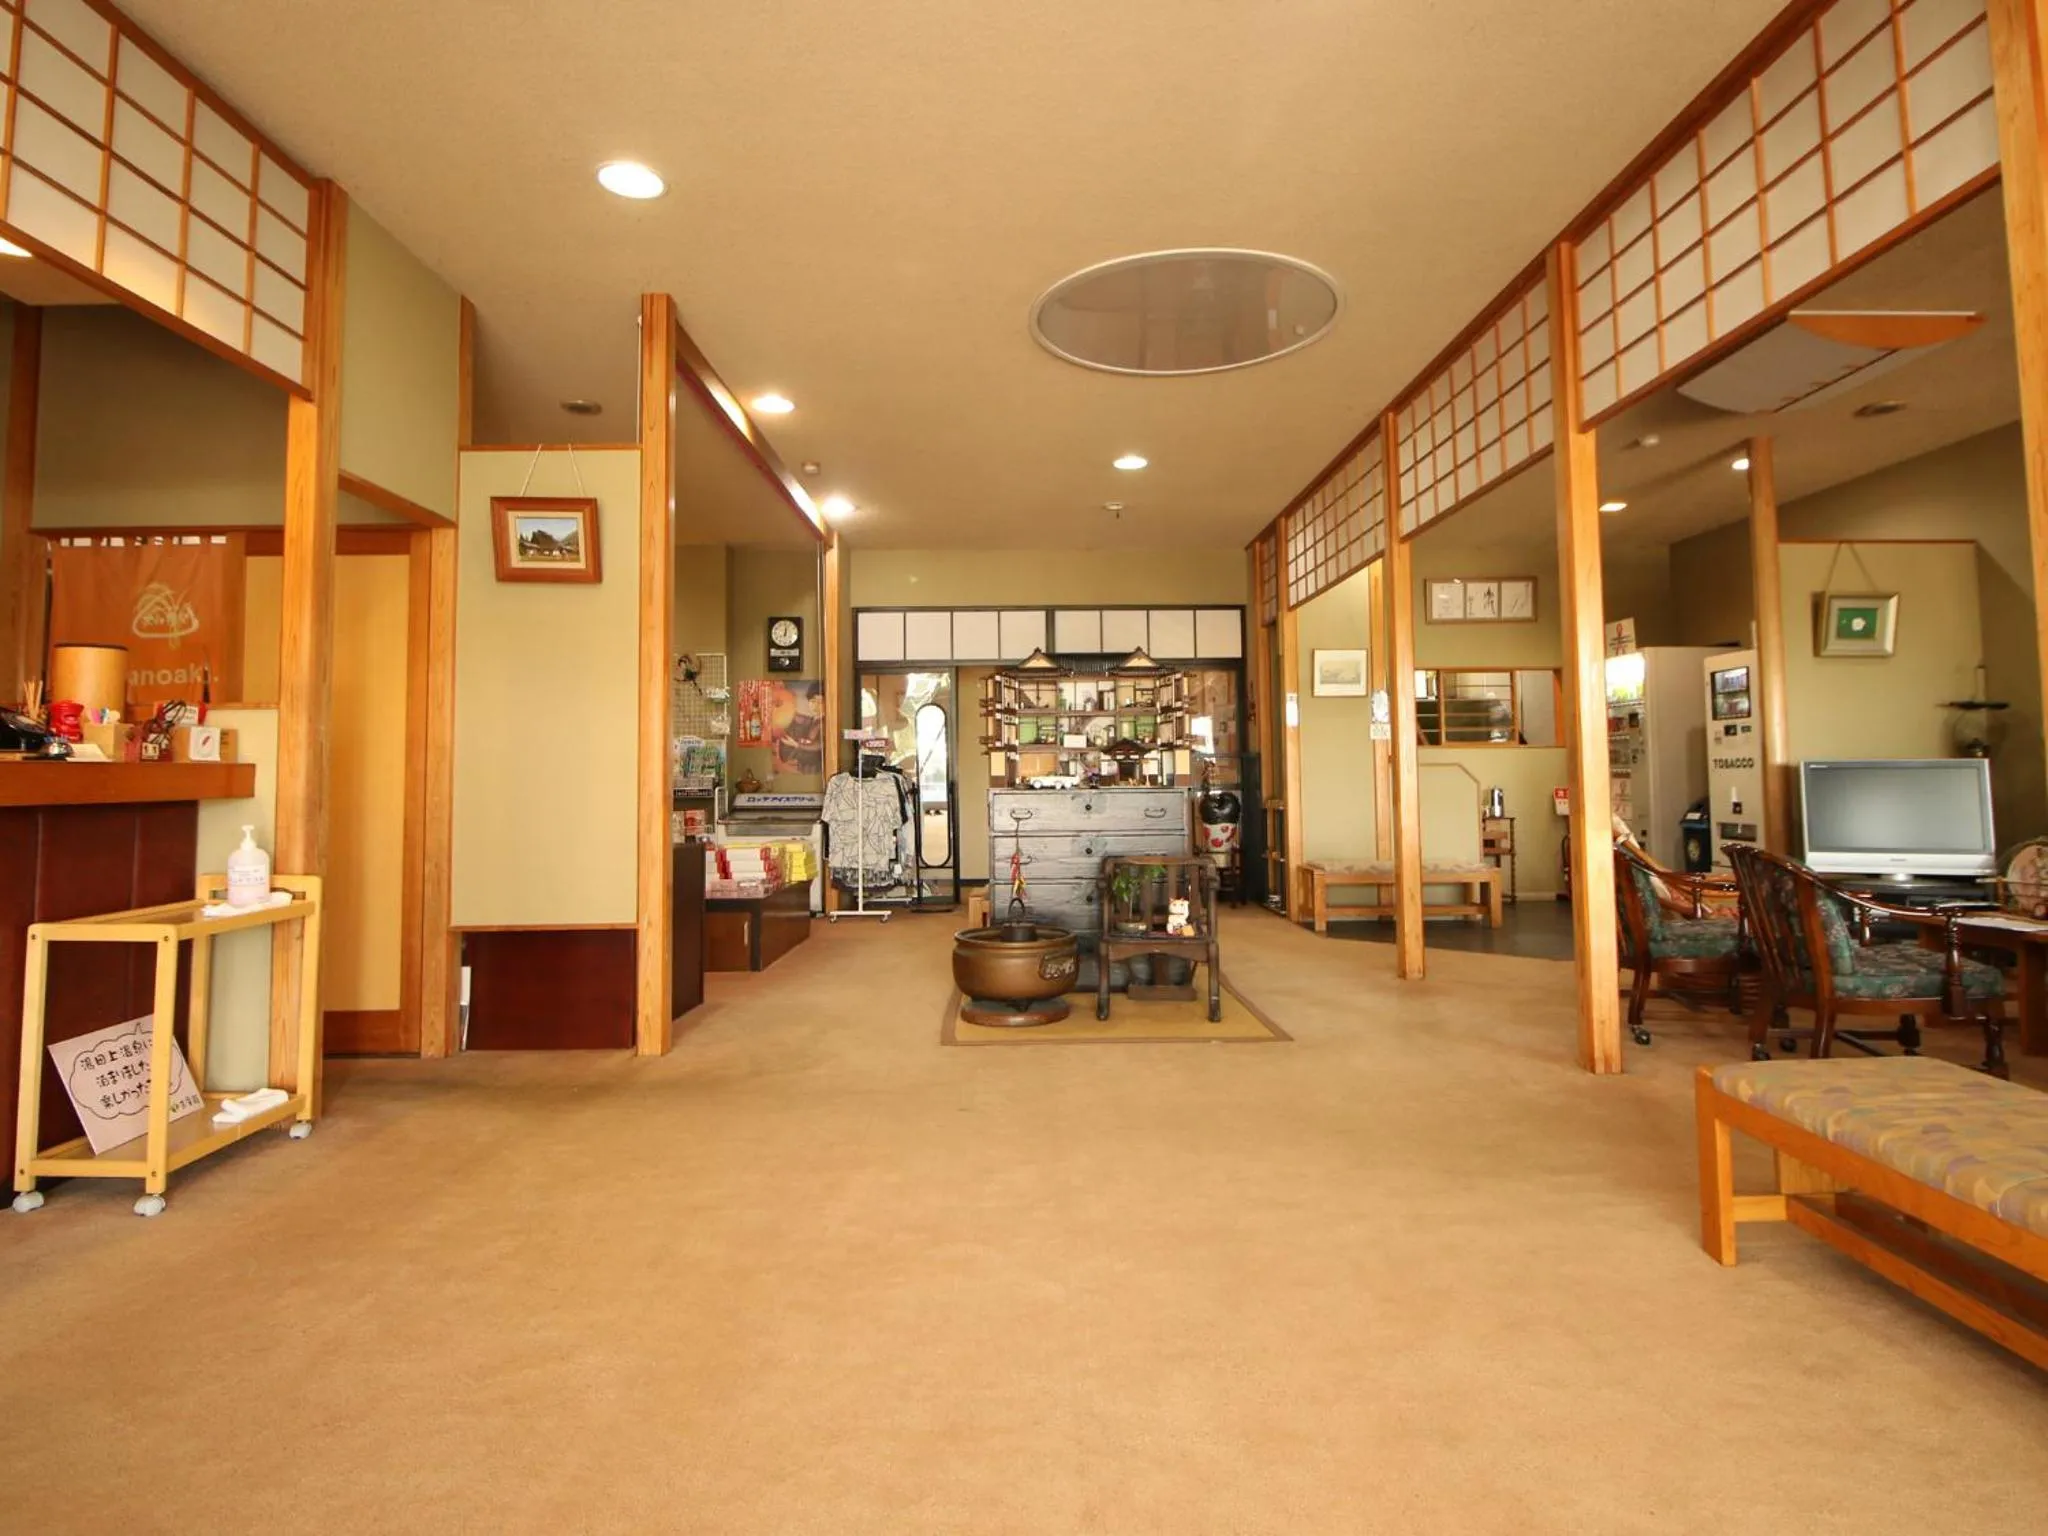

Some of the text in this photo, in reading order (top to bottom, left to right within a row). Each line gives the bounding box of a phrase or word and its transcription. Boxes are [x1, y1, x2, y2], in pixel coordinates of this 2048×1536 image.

[128, 663, 218, 686] anoak.
[1712, 757, 1754, 770] TOBACCO
[100, 1078, 152, 1110] 楽しかった
